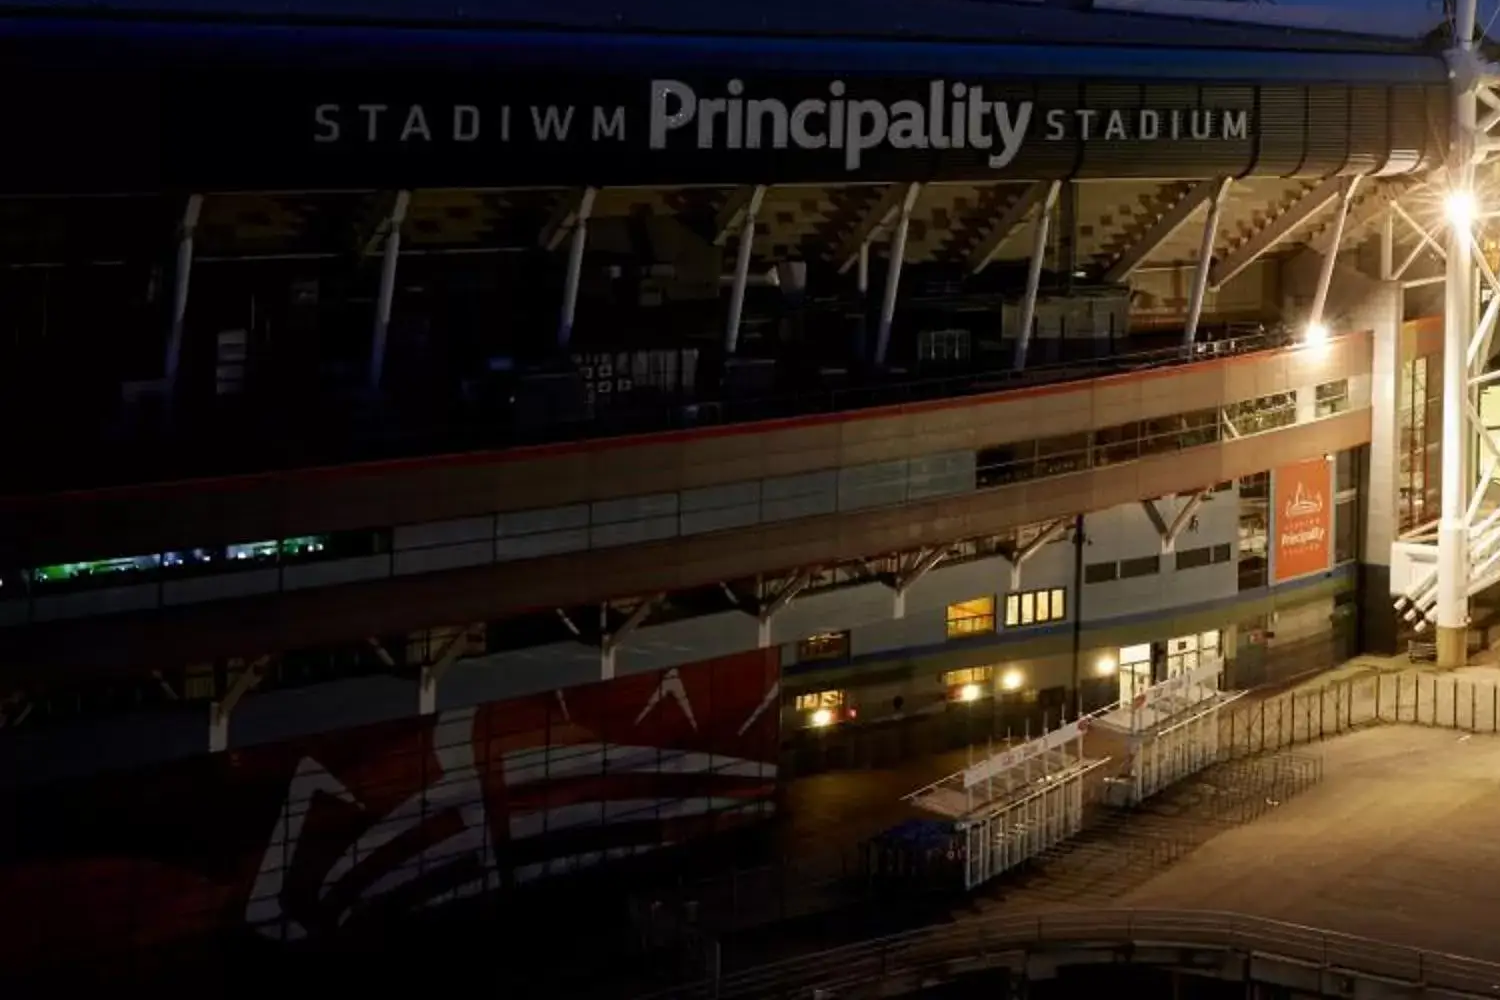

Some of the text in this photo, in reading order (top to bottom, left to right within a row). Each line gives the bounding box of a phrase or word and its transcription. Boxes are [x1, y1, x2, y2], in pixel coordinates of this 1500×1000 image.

[313, 78, 1247, 170] STADIWM Principality STADIUM
